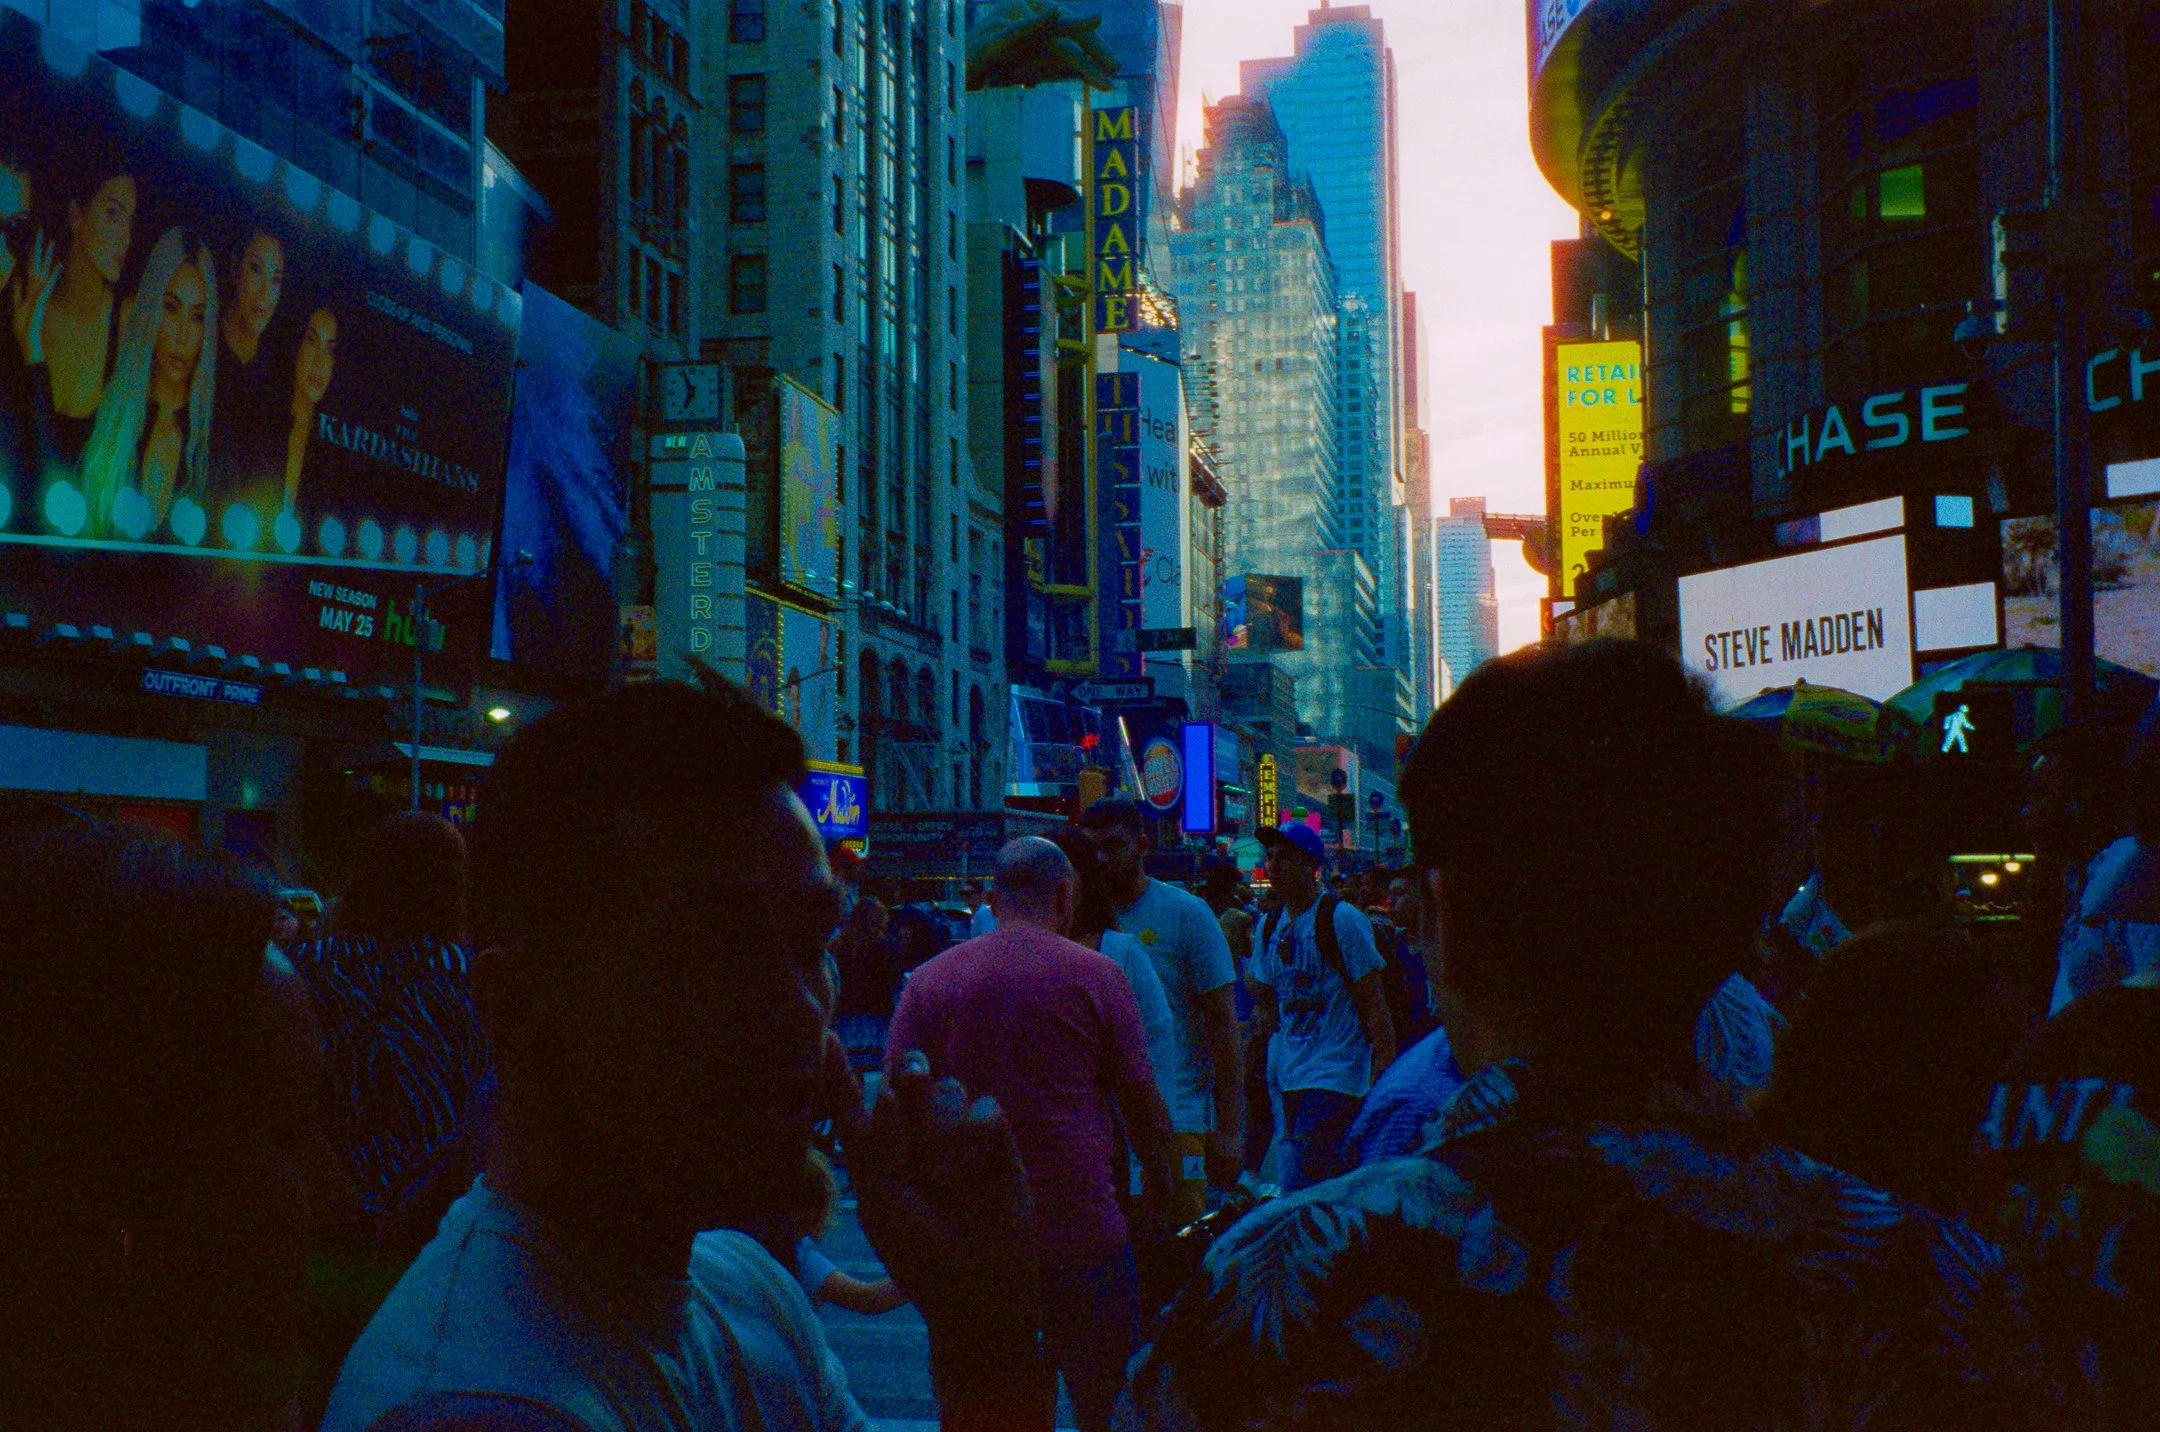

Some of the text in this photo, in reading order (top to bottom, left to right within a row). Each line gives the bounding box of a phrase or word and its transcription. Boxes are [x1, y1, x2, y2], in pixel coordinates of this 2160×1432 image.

[1096, 107, 1135, 331] MADAME
[1565, 388, 1615, 409] FOR
[319, 411, 481, 492] KARDASHIANS
[1569, 431, 1587, 444] 50
[1569, 443, 1626, 458] Annual
[688, 433, 716, 653] AMSTERD
[1570, 526, 1596, 538] Per
[308, 579, 379, 610] NEW SEASON
[319, 605, 375, 638] MAY 25
[383, 598, 446, 648] hu
[1704, 607, 1885, 673] STEVE MADDEN
[143, 671, 261, 705] OUTFRONT PRIME
[1115, 685, 1143, 697] WAY
